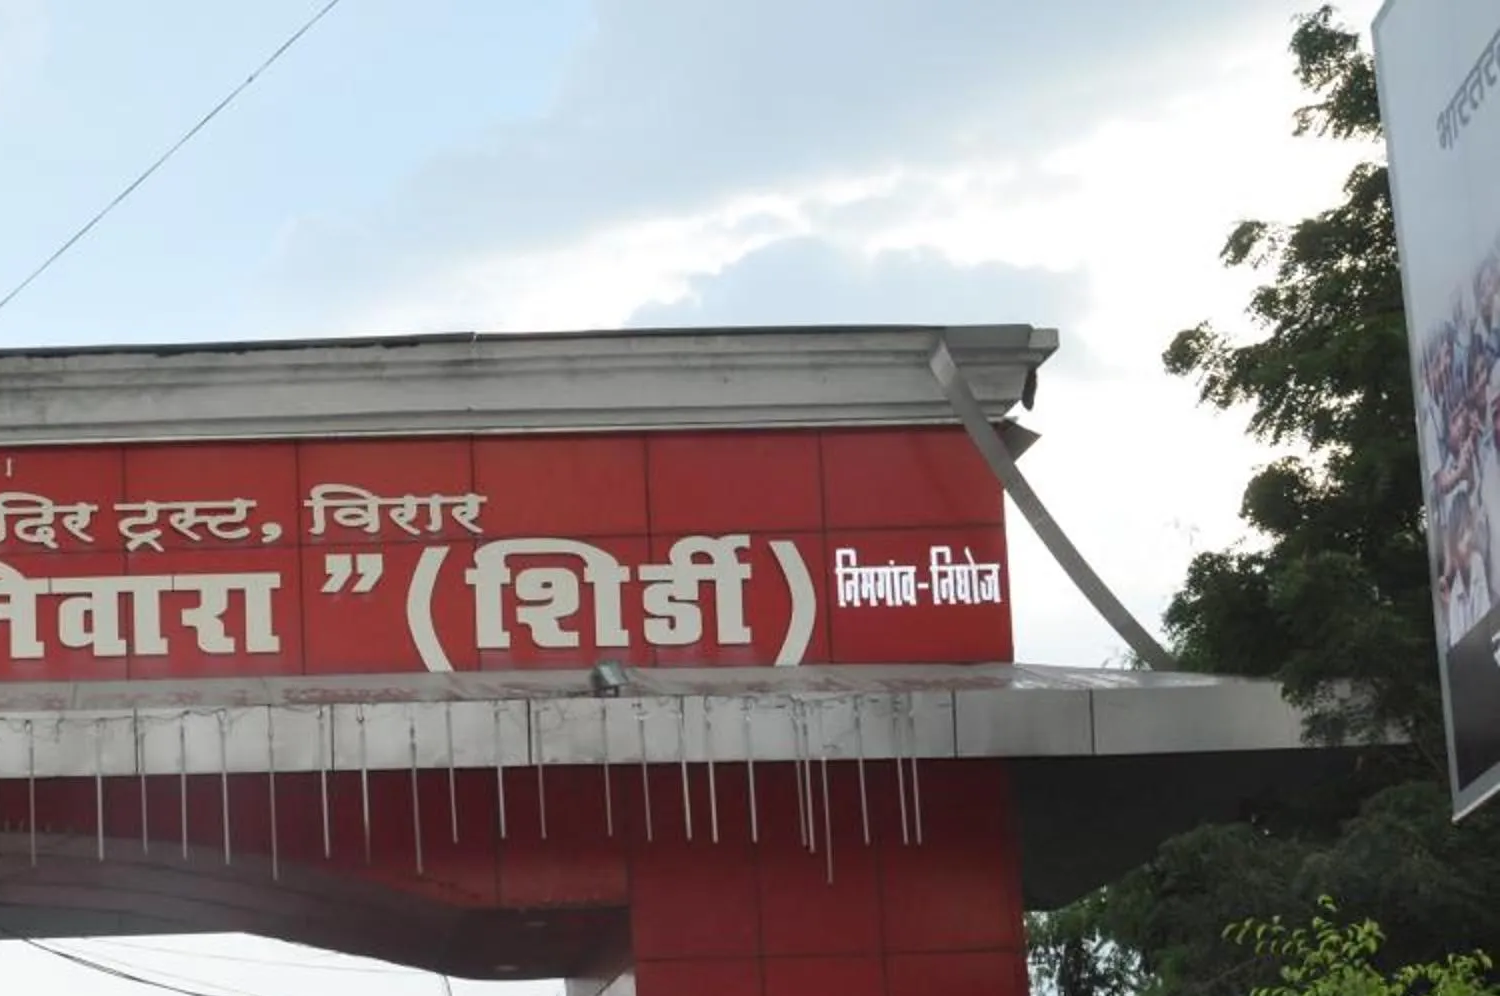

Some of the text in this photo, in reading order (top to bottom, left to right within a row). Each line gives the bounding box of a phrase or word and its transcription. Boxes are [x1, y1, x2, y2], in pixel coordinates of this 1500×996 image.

[1436, 28, 1500, 150] भारतर
[113, 497, 282, 552] ट्रस्ट,
[307, 483, 487, 536] विरार
